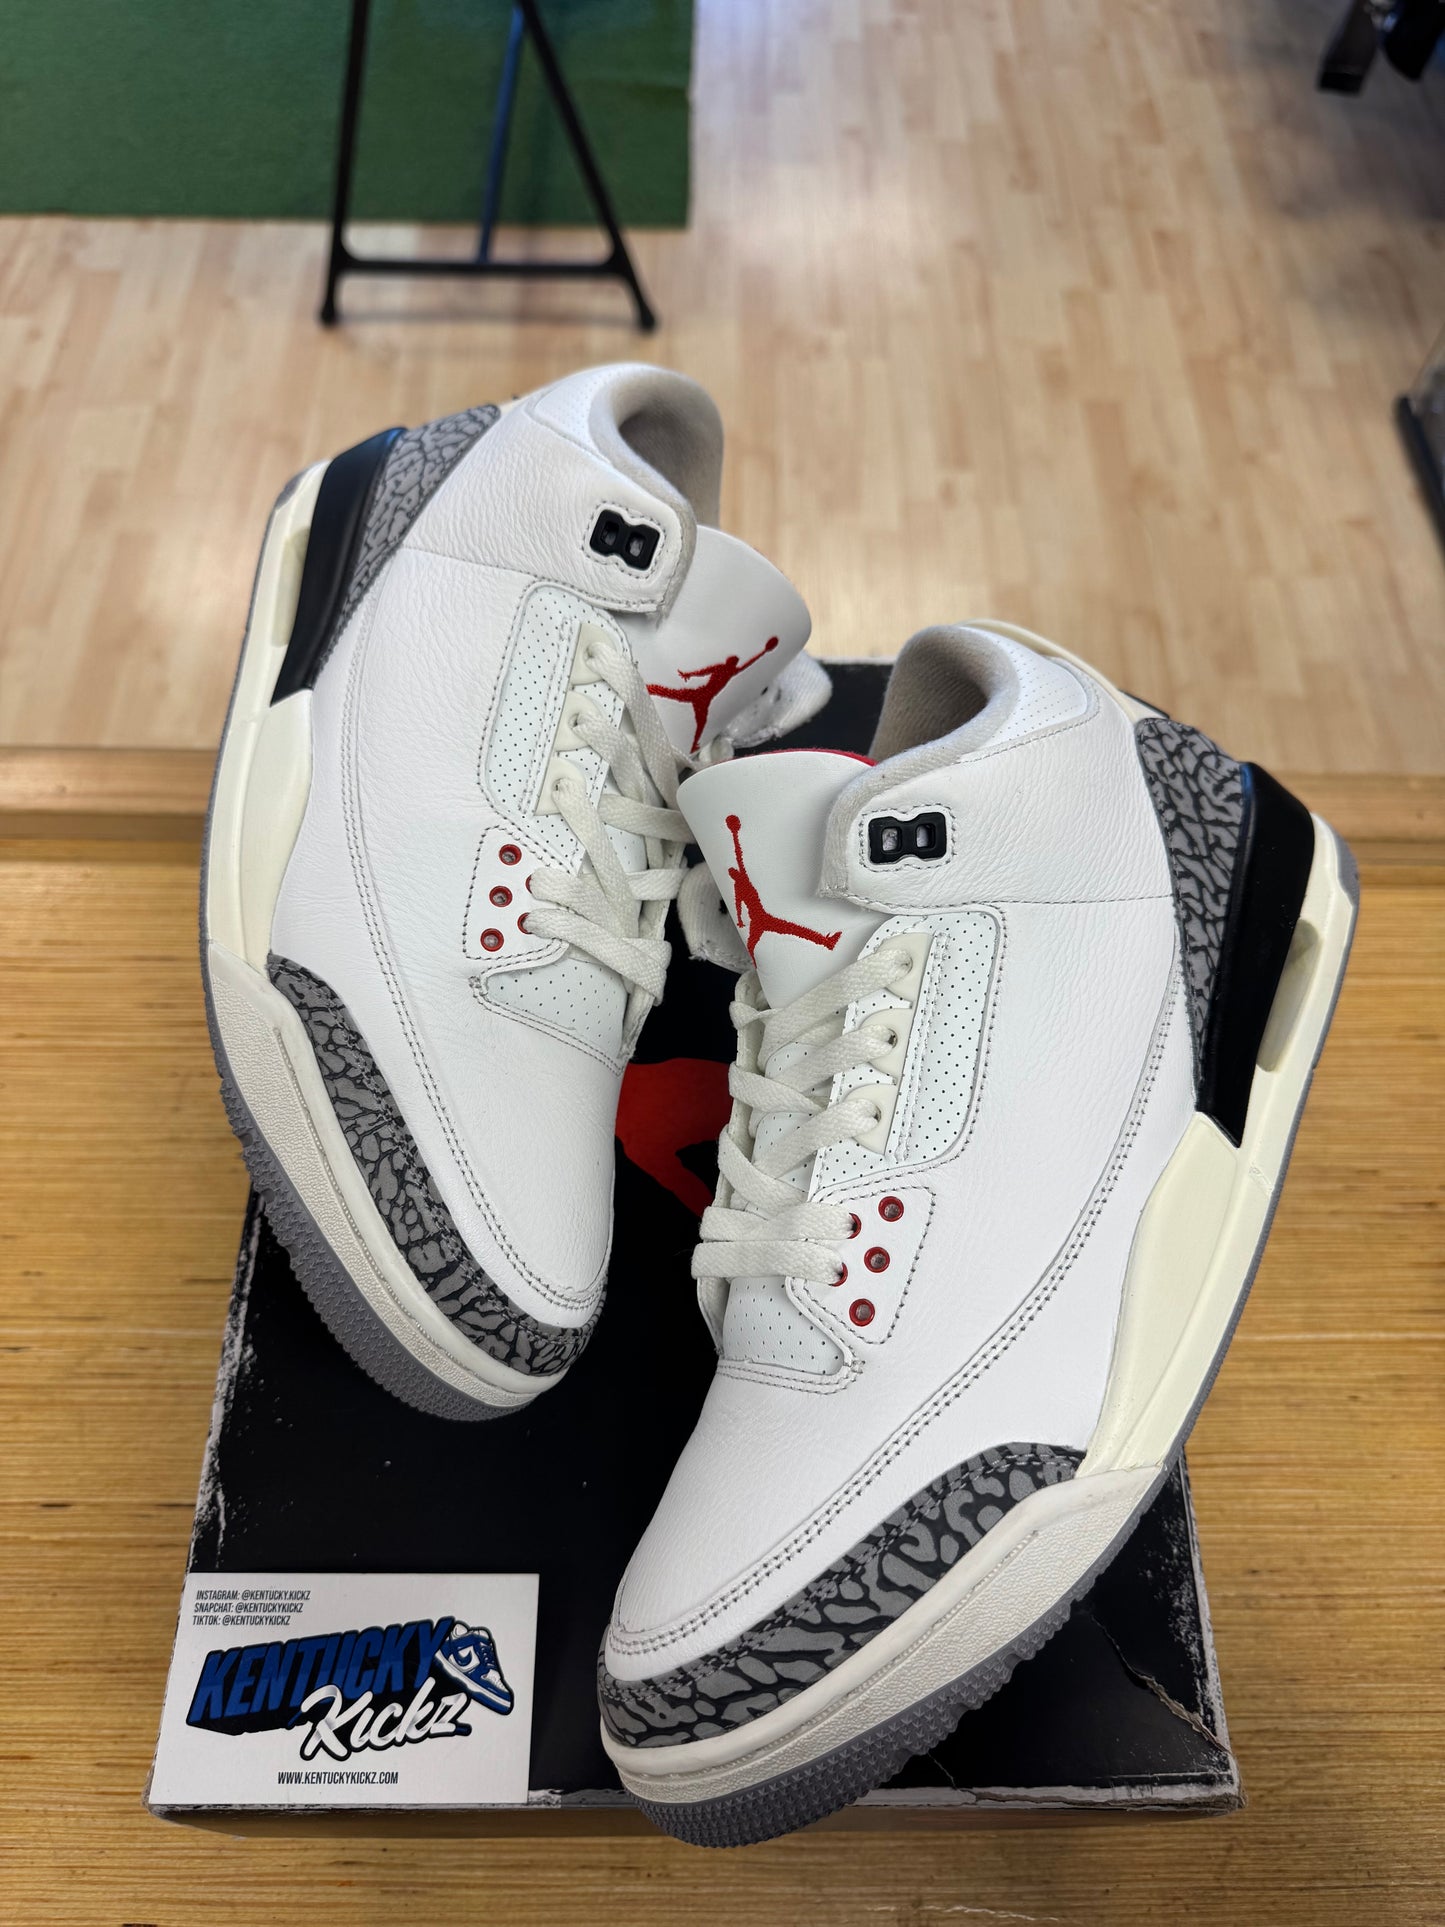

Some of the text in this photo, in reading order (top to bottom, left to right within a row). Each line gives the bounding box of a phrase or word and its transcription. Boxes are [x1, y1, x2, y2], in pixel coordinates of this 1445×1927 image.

[196, 1589, 311, 1601] INSTAGRAM: @KENTUCKY.KICKZ
[194, 1602, 304, 1613] SNAPCHAT: @KENTUCKYKICKZ
[192, 1614, 291, 1626] TIKTOK: @KENTUCKYKICKZ
[188, 1616, 455, 1725] KENTUCKY
[300, 1676, 469, 1759] Kickz
[277, 1771, 399, 1785] WWW.KENTUCKYKICKZ.COM
